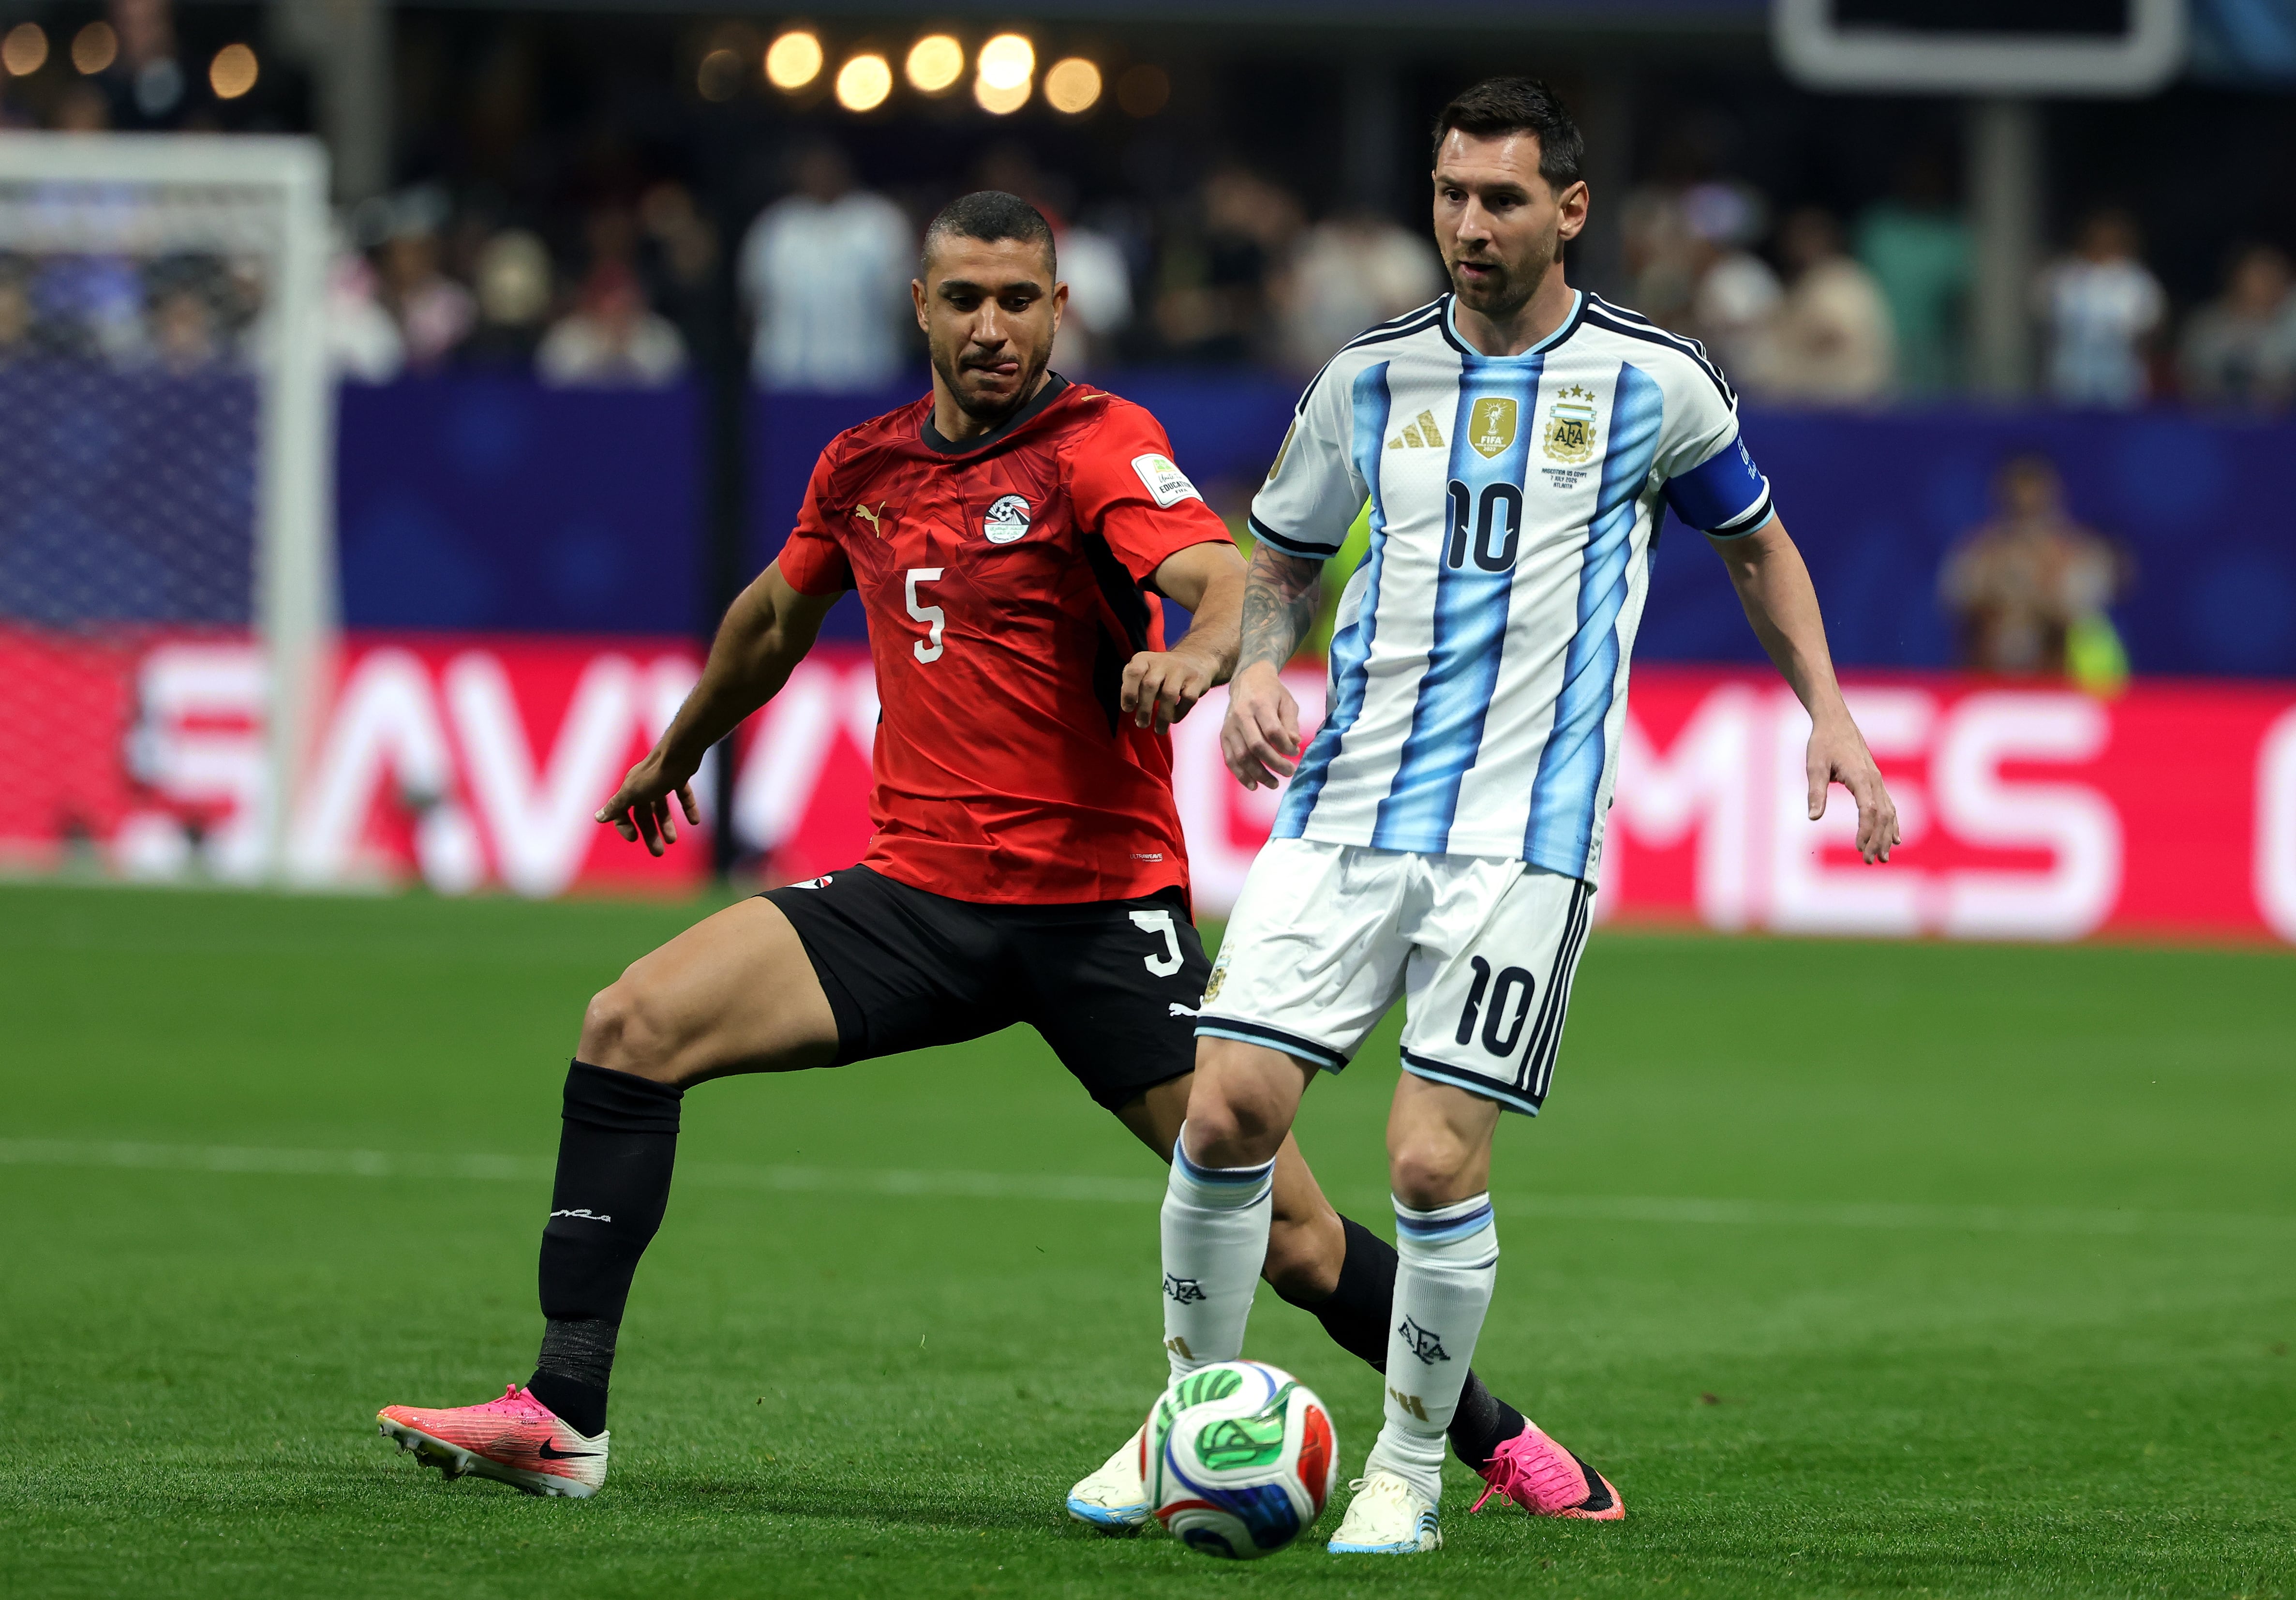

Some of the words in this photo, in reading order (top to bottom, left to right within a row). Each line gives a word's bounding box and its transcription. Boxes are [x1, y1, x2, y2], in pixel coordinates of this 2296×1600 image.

[1554, 419, 1584, 448] AFA
[1159, 481, 1193, 493] EDUCATION
[1447, 479, 1523, 573] 10
[905, 568, 945, 664] 5
[116, 645, 878, 897] SAVV
[1455, 956, 1535, 1058] 10
[1163, 1272, 1206, 1305] AFA
[1398, 1314, 1451, 1365] AFA
